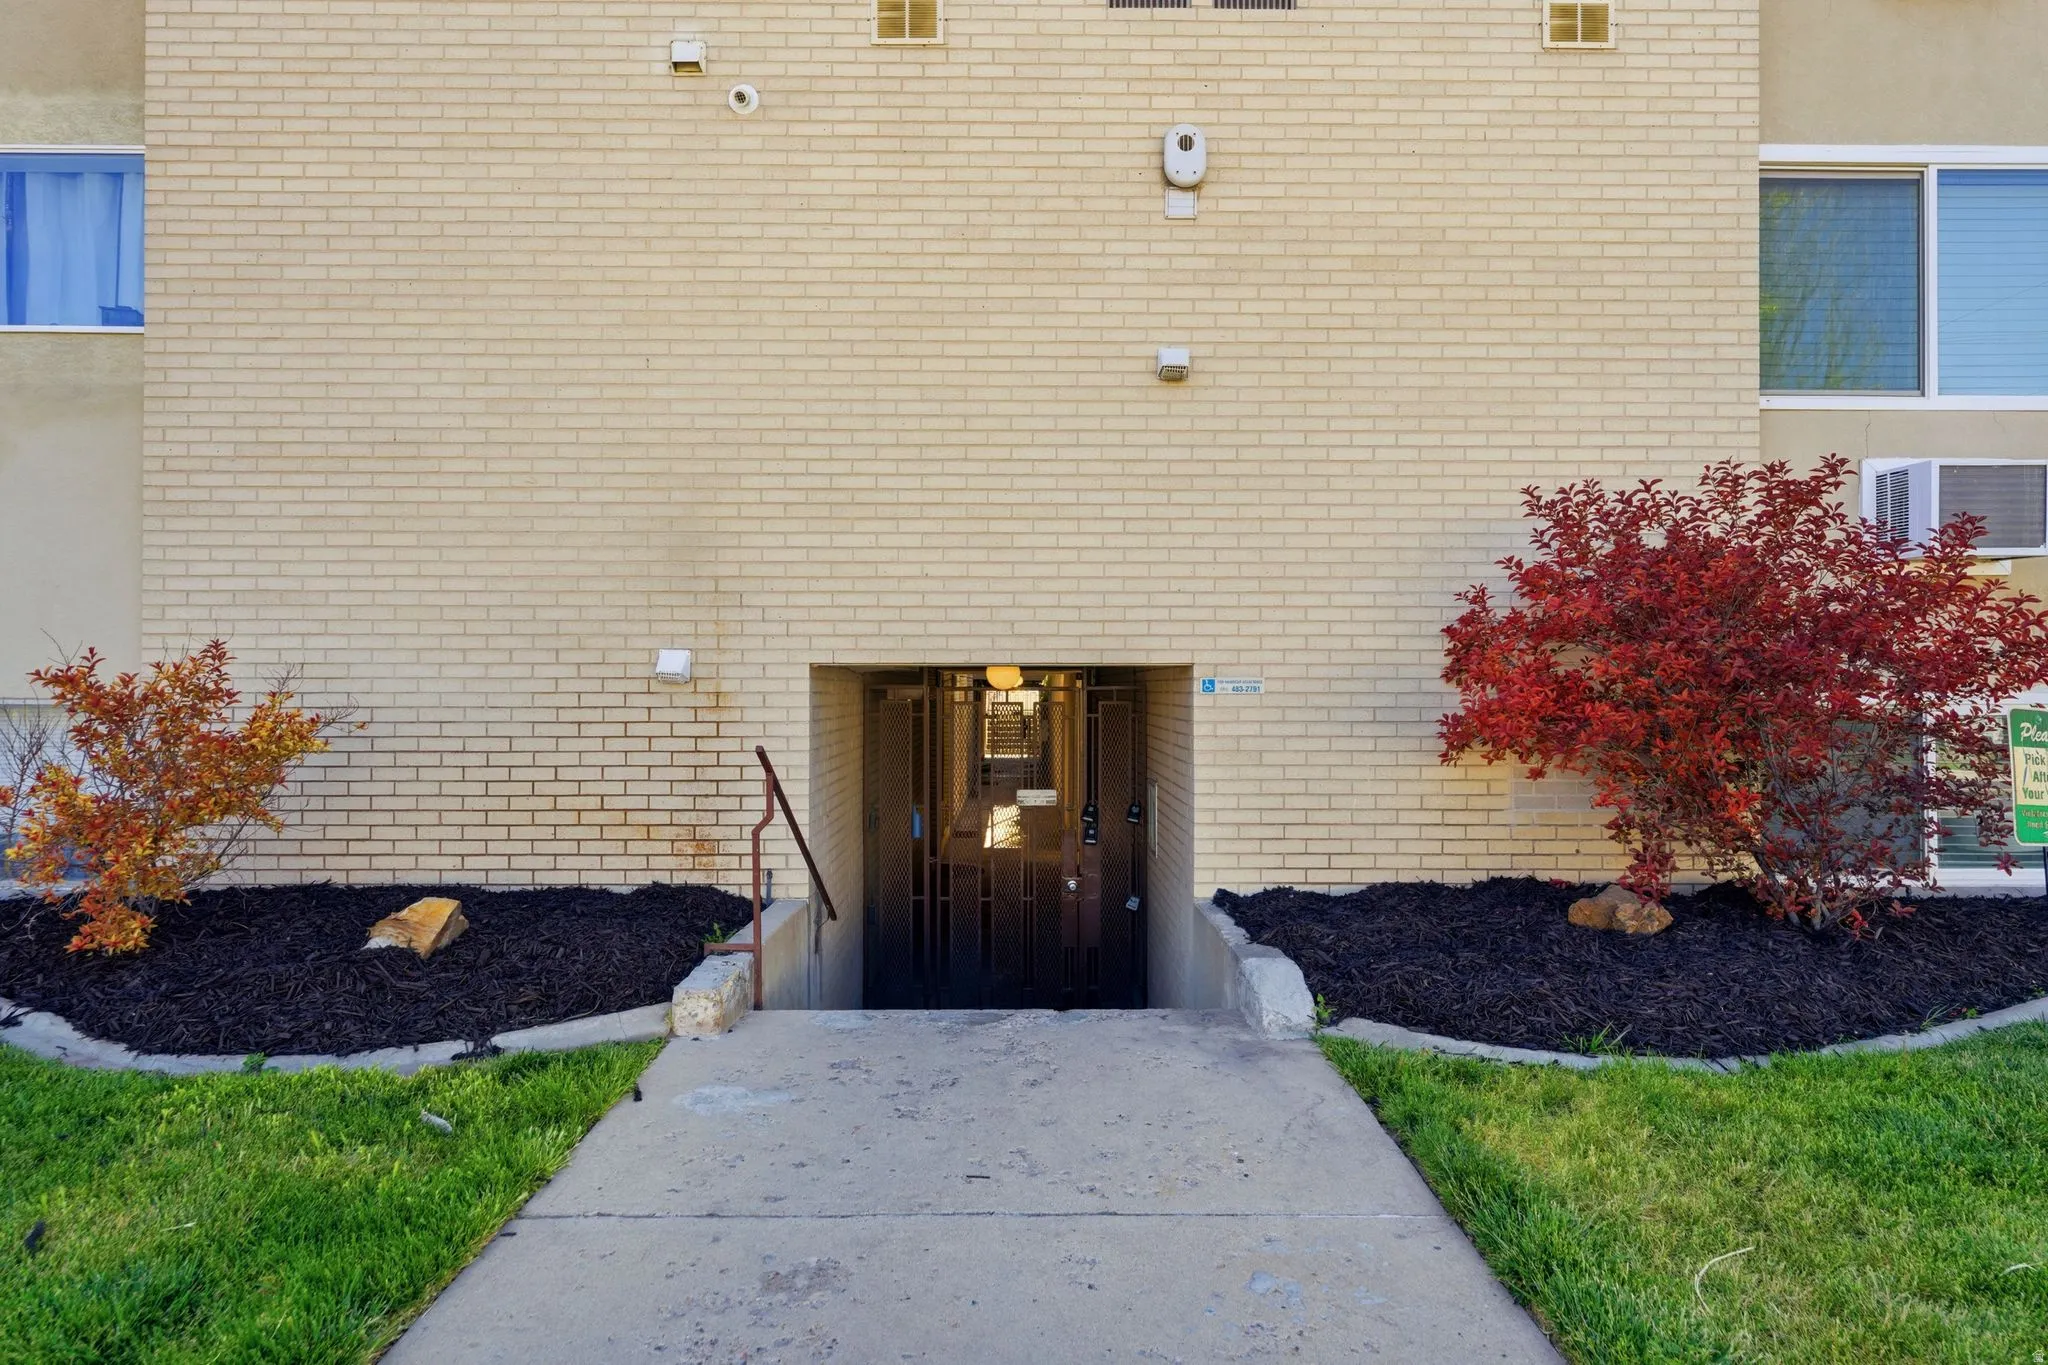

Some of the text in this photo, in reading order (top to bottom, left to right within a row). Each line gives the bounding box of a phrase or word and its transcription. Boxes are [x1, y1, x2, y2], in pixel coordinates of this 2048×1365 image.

[2025, 753, 2046, 766] Pick
[2032, 770, 2048, 783] Aft
[2022, 787, 2044, 800] Your
